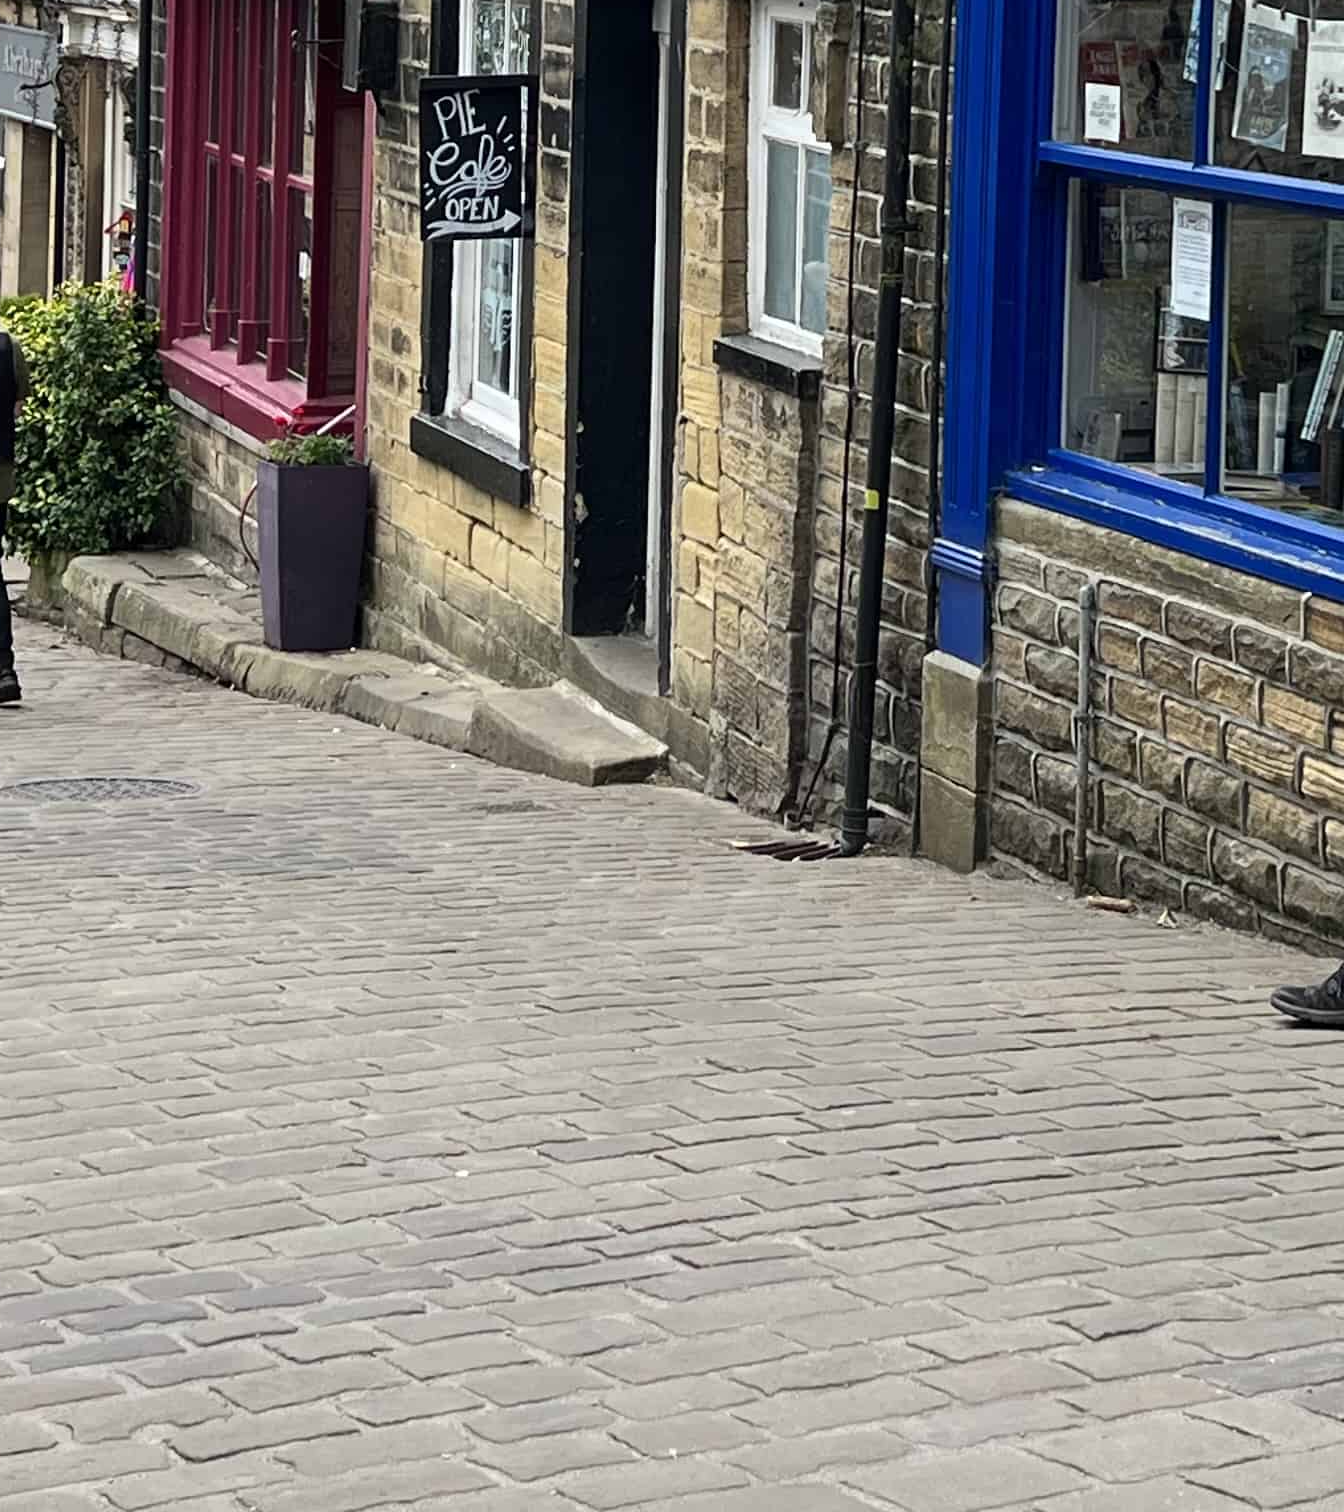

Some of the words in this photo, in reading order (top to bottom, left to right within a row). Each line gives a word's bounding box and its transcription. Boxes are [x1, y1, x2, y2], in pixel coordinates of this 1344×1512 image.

[433, 89, 487, 141] PIE
[426, 134, 512, 198] Cafe
[445, 195, 499, 221] OPEN
